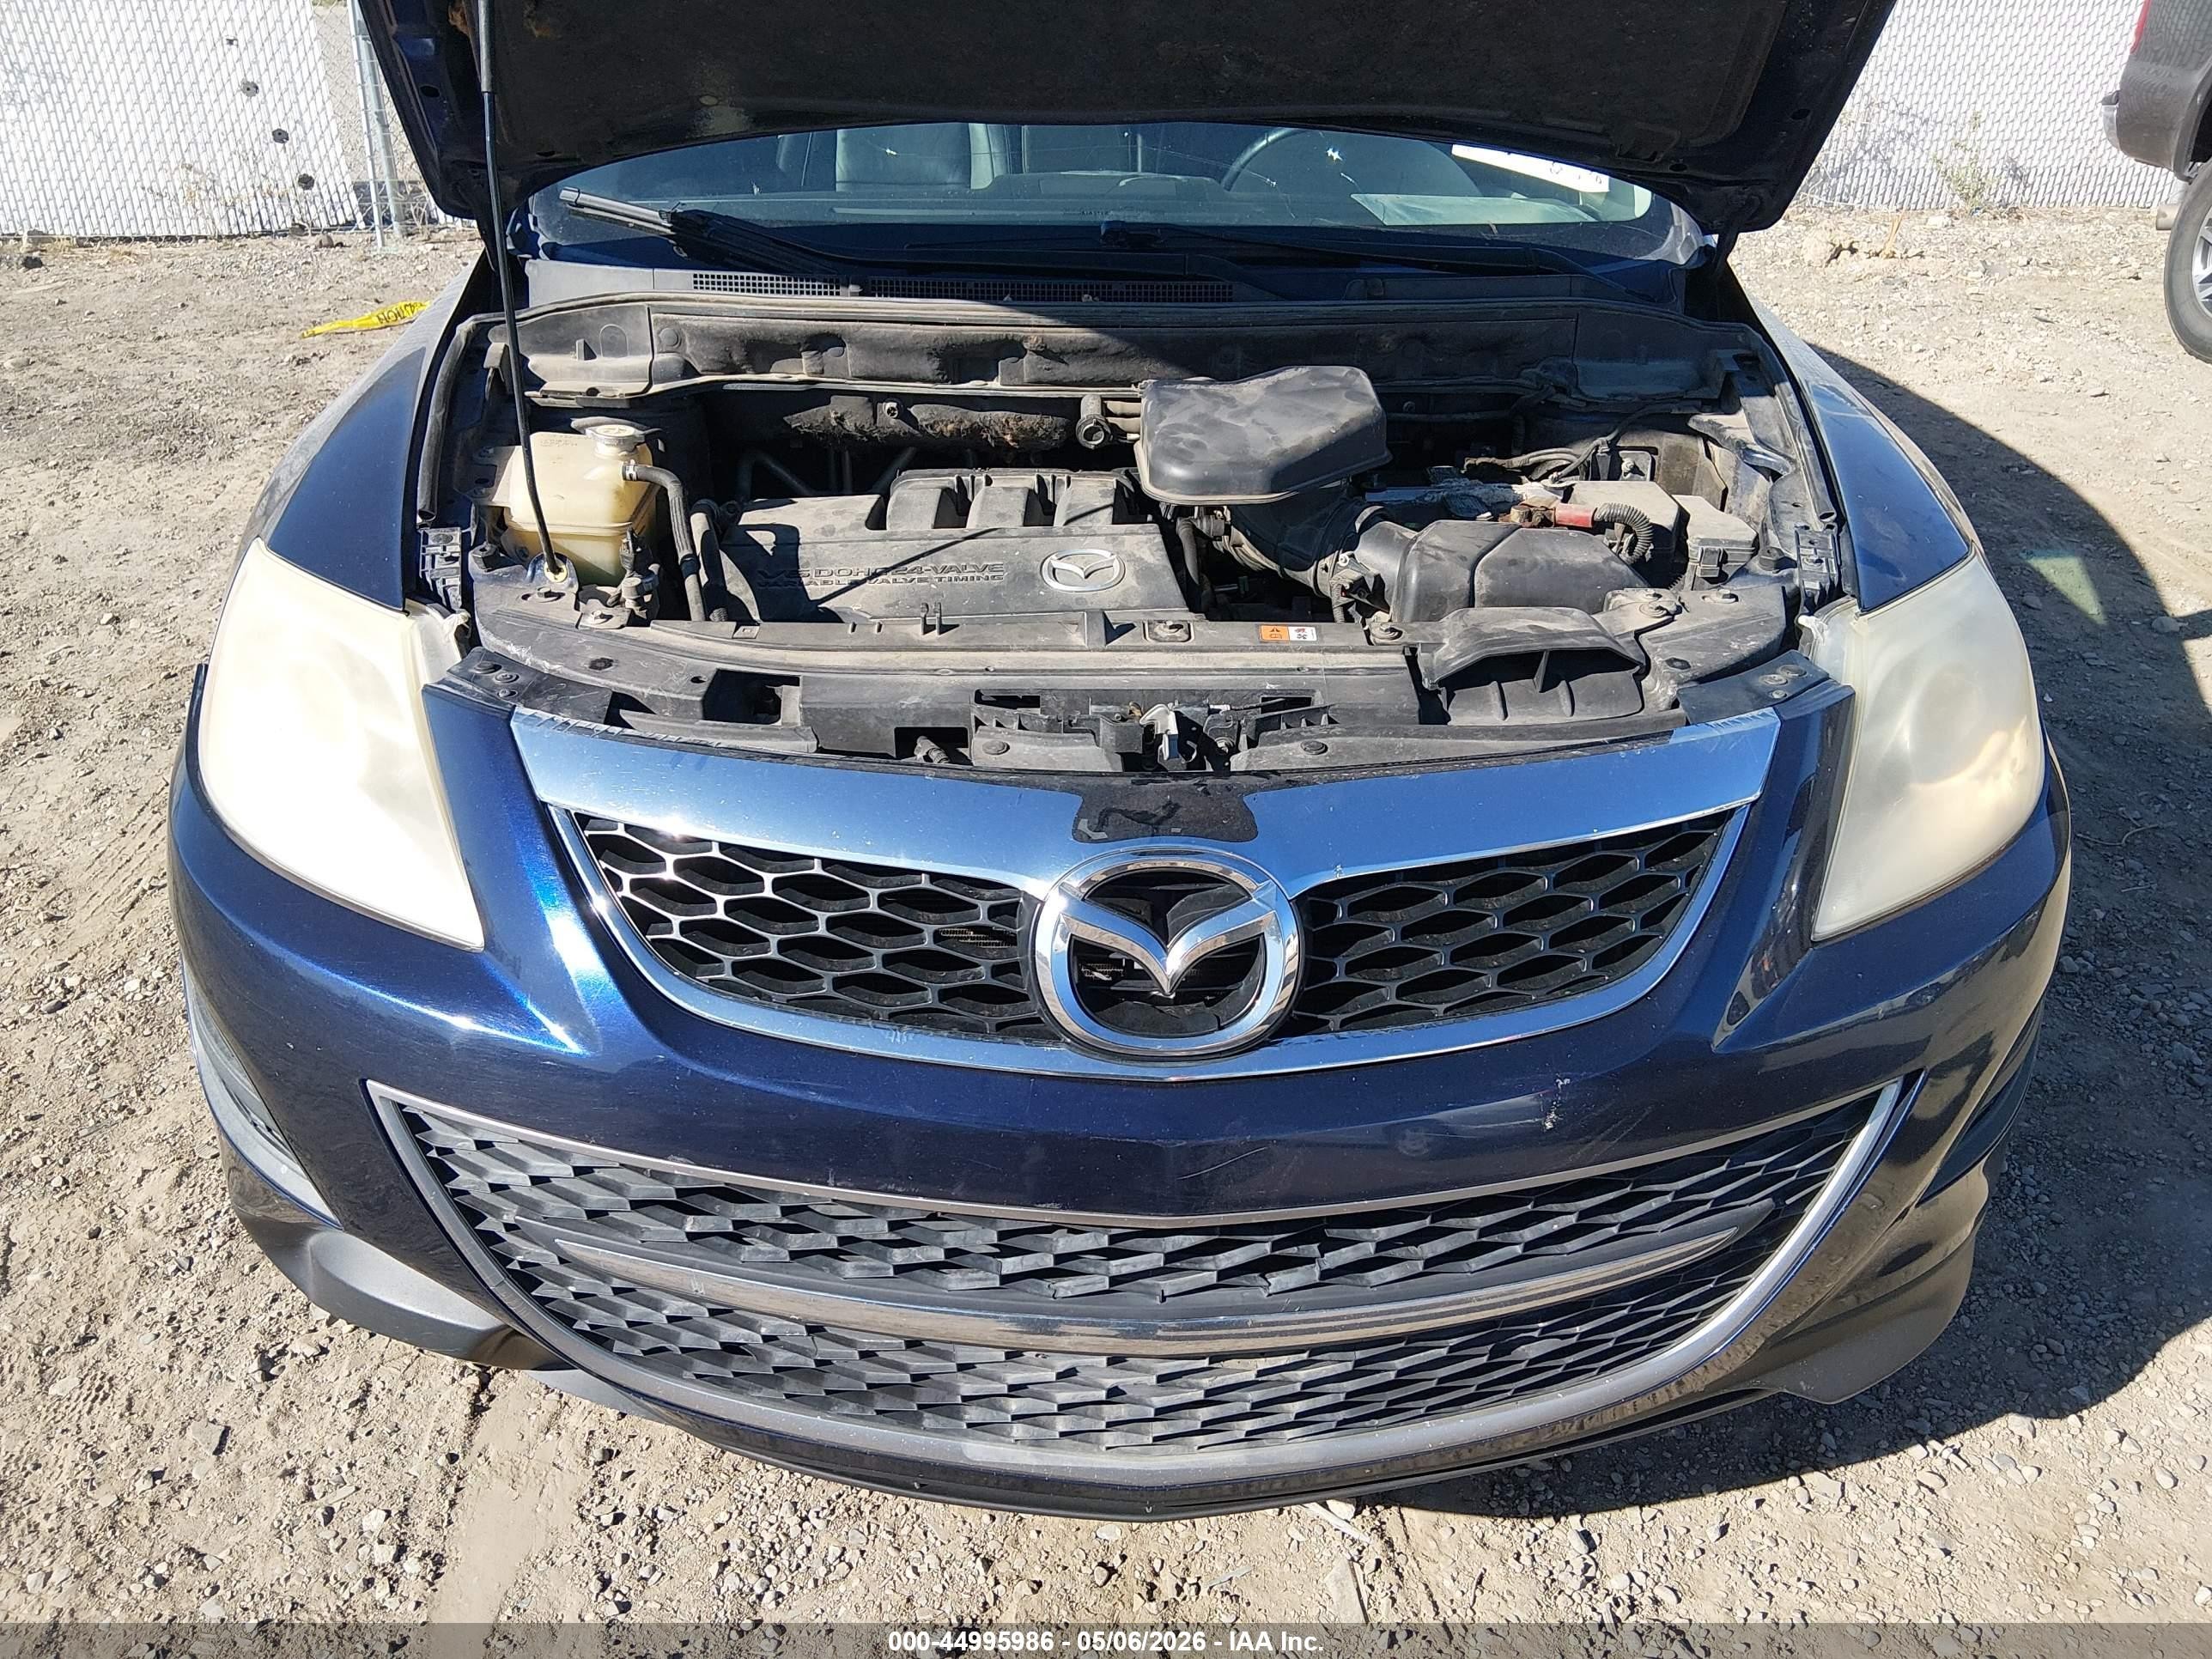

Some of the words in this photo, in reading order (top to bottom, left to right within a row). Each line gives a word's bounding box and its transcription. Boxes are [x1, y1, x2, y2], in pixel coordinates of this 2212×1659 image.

[757, 568, 811, 580] V6
[814, 566, 888, 578] DOHC
[890, 563, 1004, 575] 24-VALVE
[756, 577, 864, 588] VARIABLE
[866, 576, 930, 586] VALVE
[934, 574, 1005, 584] TIMING
